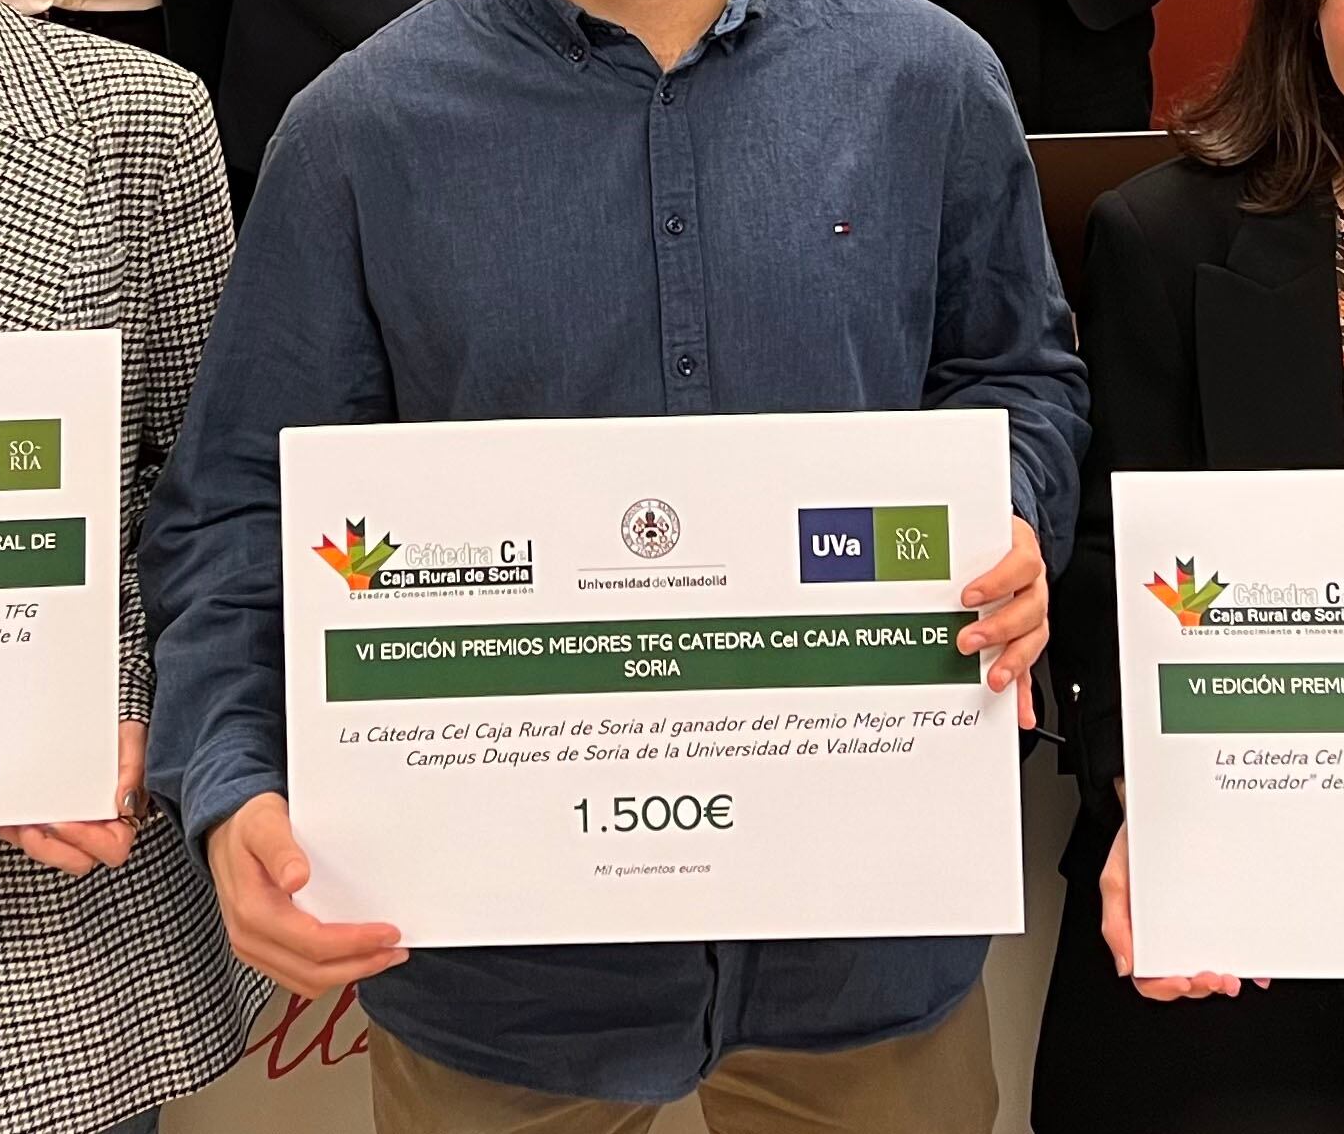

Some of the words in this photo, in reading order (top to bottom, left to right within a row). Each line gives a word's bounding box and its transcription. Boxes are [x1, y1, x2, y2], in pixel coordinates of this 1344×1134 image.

[10, 455, 42, 471] RIA
[30, 532, 56, 550] DE
[812, 534, 861, 557] UVa
[405, 543, 493, 567] Cátedra
[896, 543, 930, 560] RIA
[379, 571, 415, 588] Caja
[419, 569, 461, 584] Rural
[464, 568, 485, 583] de
[488, 567, 530, 582] Soria
[578, 577, 651, 590] Universidad
[652, 577, 666, 588] de
[667, 575, 727, 587] Valladolid
[5, 603, 40, 620] TFG
[15, 627, 32, 643] la
[355, 643, 375, 661] VI
[380, 637, 456, 660] EDICIÓN
[461, 637, 544, 658] PREMIOS
[549, 634, 633, 655] MEJORES
[636, 633, 673, 652] TFG
[678, 631, 766, 651] CATEDRA
[803, 629, 850, 648] CAJA
[855, 627, 918, 646] RURAL
[921, 626, 949, 645] DE
[624, 658, 681, 678] SORIA
[1188, 677, 1207, 695] VI
[1211, 673, 1286, 695] EDICIÓN
[339, 727, 360, 744] La
[366, 725, 436, 743] Cátedra
[475, 722, 513, 744] Caja
[518, 720, 566, 738] Rural
[570, 719, 593, 736] de
[597, 719, 644, 735] Soria
[649, 717, 667, 734] al
[670, 715, 747, 738] ganador
[751, 714, 780, 731] del
[784, 713, 848, 730] Premio
[853, 712, 906, 733] Mejor
[912, 710, 947, 727] TFG
[951, 709, 981, 727] del
[406, 750, 477, 770] Campus
[482, 747, 551, 768] Duques
[556, 745, 579, 762] de
[583, 744, 630, 761] Soria
[636, 743, 659, 760] de
[664, 742, 680, 759] la
[686, 739, 792, 758] Universidad
[796, 739, 819, 755] de
[827, 736, 915, 754] Valladolid
[1215, 749, 1236, 766] La
[1242, 749, 1309, 766] Cátedra
[573, 793, 734, 834] 1.500€
[593, 864, 613, 876] Mil
[614, 865, 676, 878] quinientos
[678, 864, 712, 874] euros
